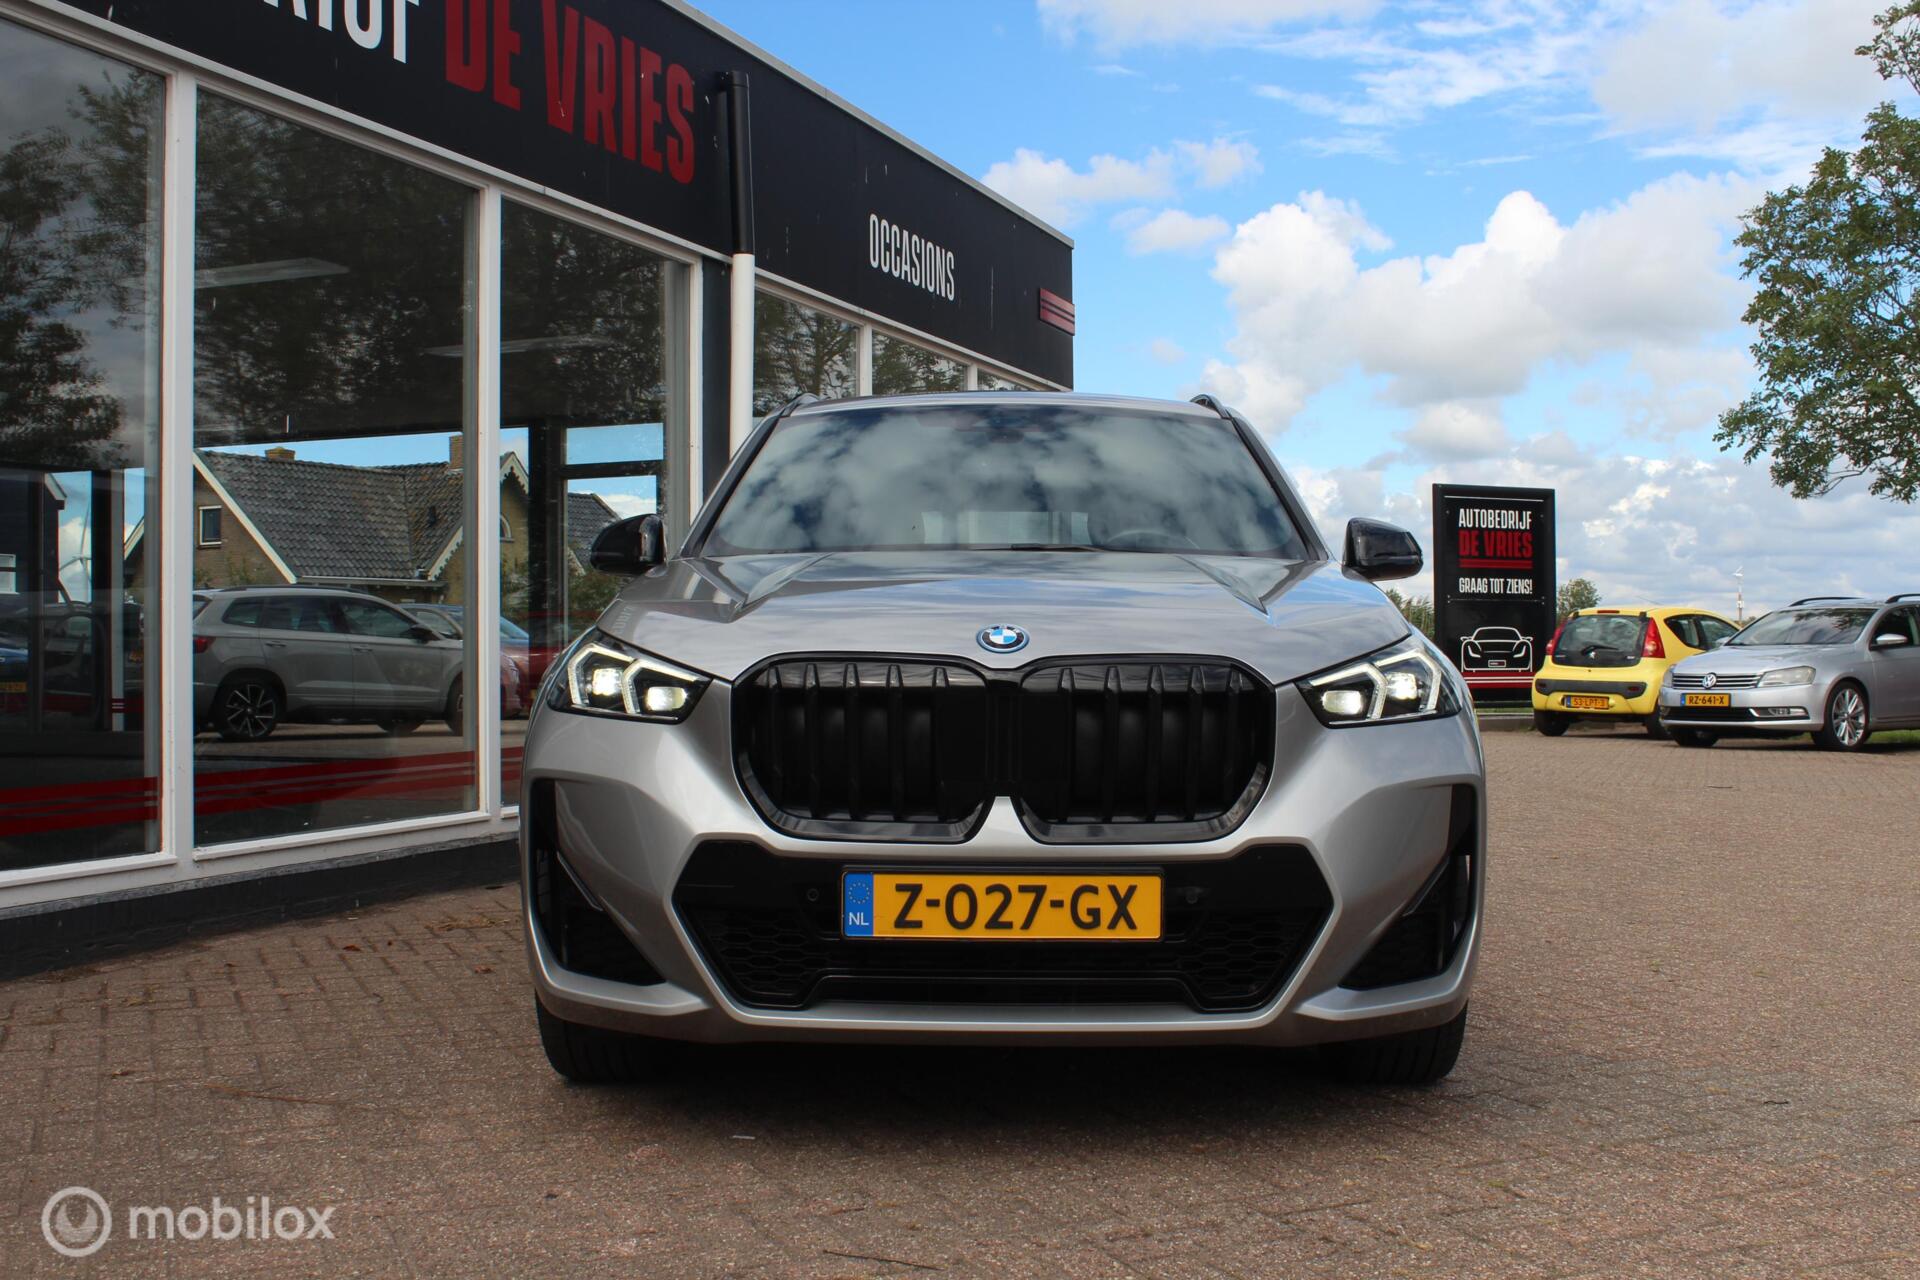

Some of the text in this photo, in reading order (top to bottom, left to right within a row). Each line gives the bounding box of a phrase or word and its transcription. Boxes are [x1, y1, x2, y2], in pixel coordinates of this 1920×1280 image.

[542, 0, 695, 184] VRIES
[869, 213, 955, 301] OCCASIONS
[1458, 508, 1532, 530] AUTOBEDRIJF
[1458, 530, 1533, 558] DE VRIES
[1458, 577, 1533, 595] GRAAG TOT ZIENS!
[1688, 695, 1725, 705] RZ-641-X
[848, 911, 870, 926] NL
[893, 883, 1139, 931] Z-027-GX
